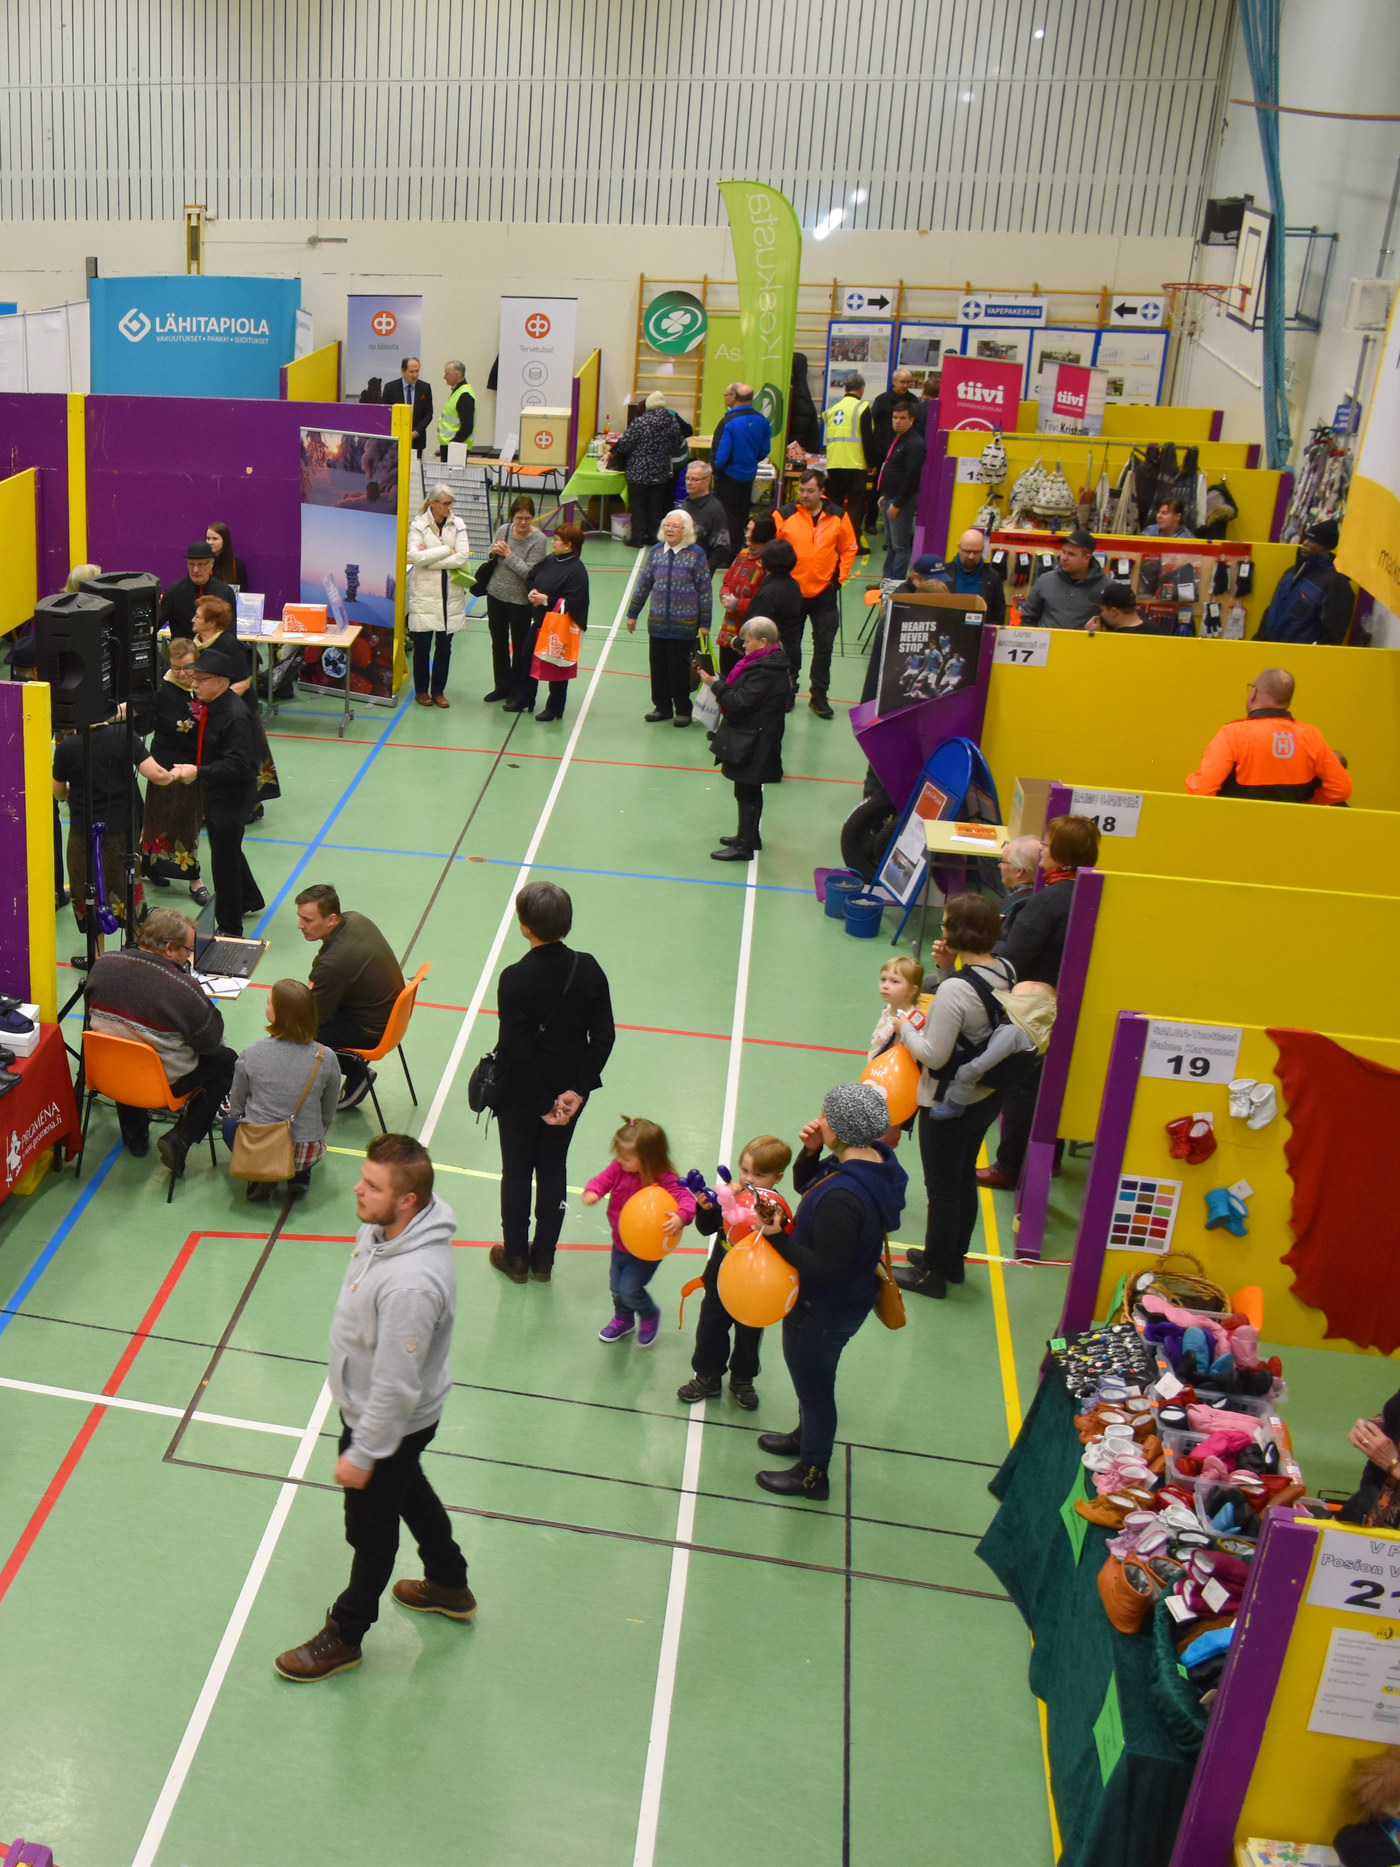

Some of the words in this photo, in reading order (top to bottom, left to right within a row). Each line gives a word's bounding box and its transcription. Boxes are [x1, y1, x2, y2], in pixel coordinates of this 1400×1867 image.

[986, 306, 1042, 317] VAPEPAKESKUS
[155, 312, 270, 336] LÄHITAPIOLA
[957, 381, 1005, 405] tiivi
[1057, 391, 1084, 407] tiivi
[901, 621, 937, 632] HEARTS
[900, 632, 929, 643] NEVER
[898, 642, 924, 653] STOP
[1007, 648, 1034, 663] 17
[1167, 1055, 1210, 1077] 19
[21, 1101, 61, 1150] PROMENA
[21, 1114, 62, 1160] www.promena.fi
[1370, 1541, 1385, 1554] V
[1321, 1554, 1384, 1575] Posion
